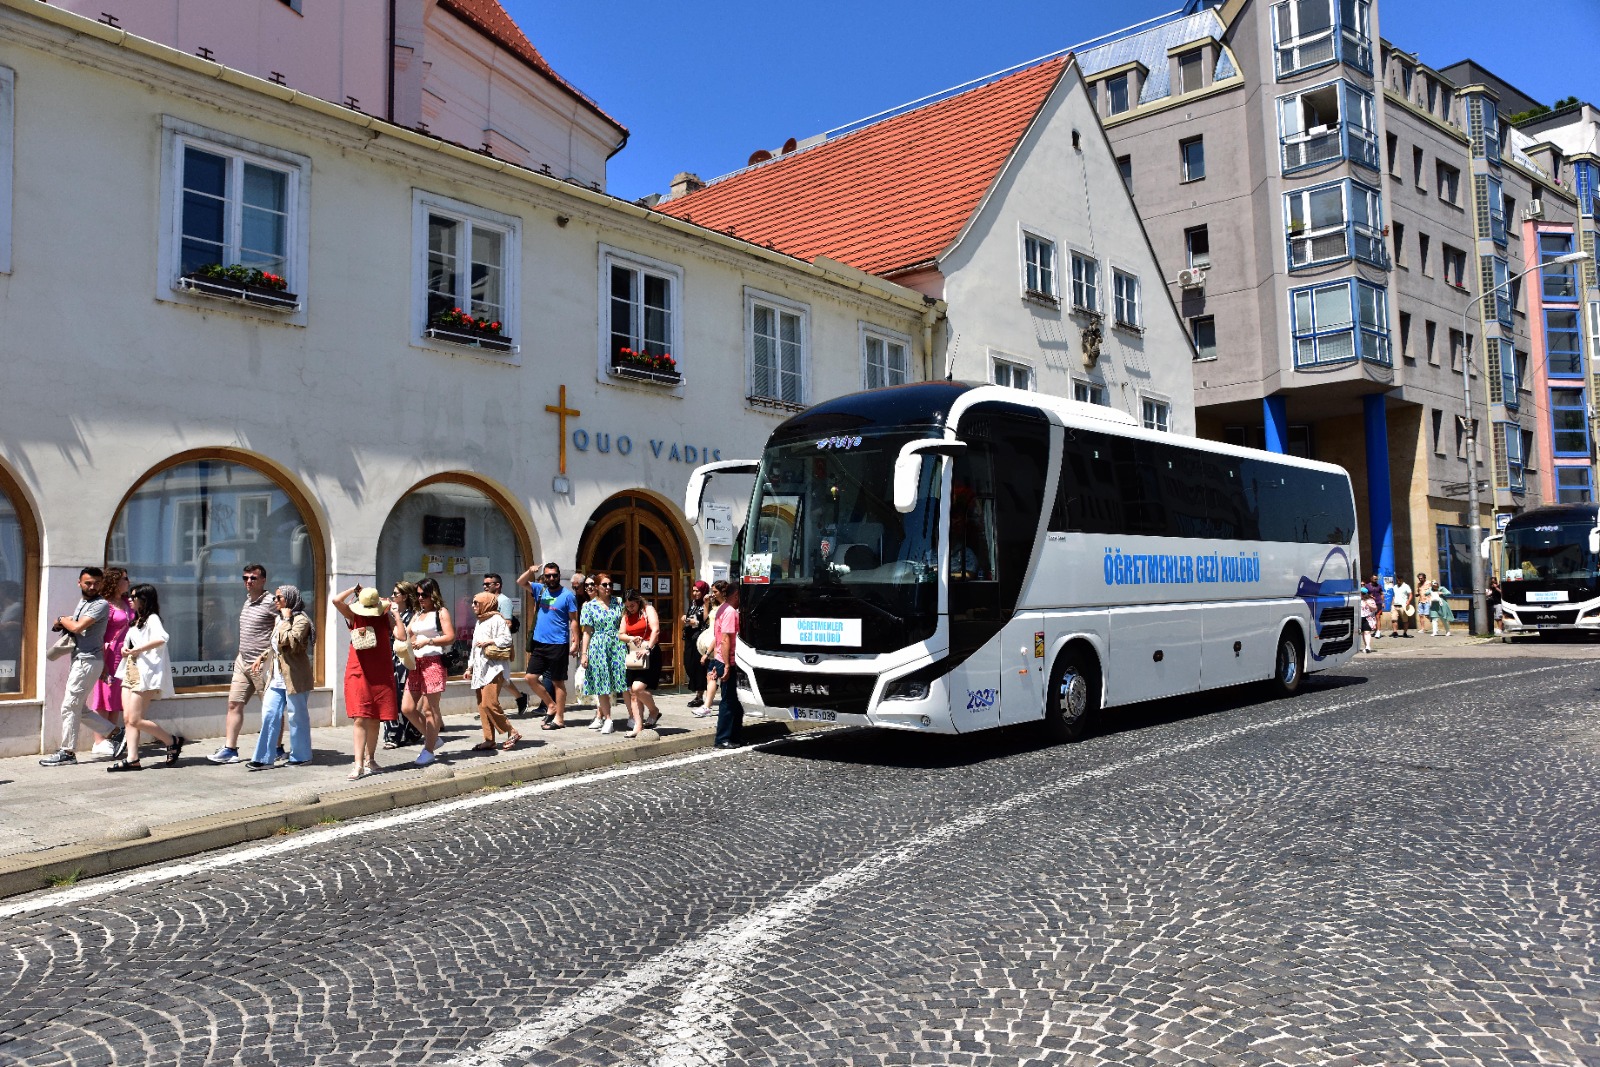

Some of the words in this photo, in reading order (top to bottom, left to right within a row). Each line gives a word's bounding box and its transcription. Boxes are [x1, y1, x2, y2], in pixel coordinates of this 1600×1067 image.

[573, 429, 633, 456] QUO
[650, 439, 721, 465] VADIS
[1104, 547, 1194, 585] ÖĞRETMENLER
[1196, 551, 1219, 583] GEZİ
[1221, 552, 1260, 583] KULÜBÜ
[814, 632, 841, 643] KULÜBÜ
[182, 662, 215, 675] pravda
[218, 664, 224, 672] a
[789, 682, 830, 696] MAN
